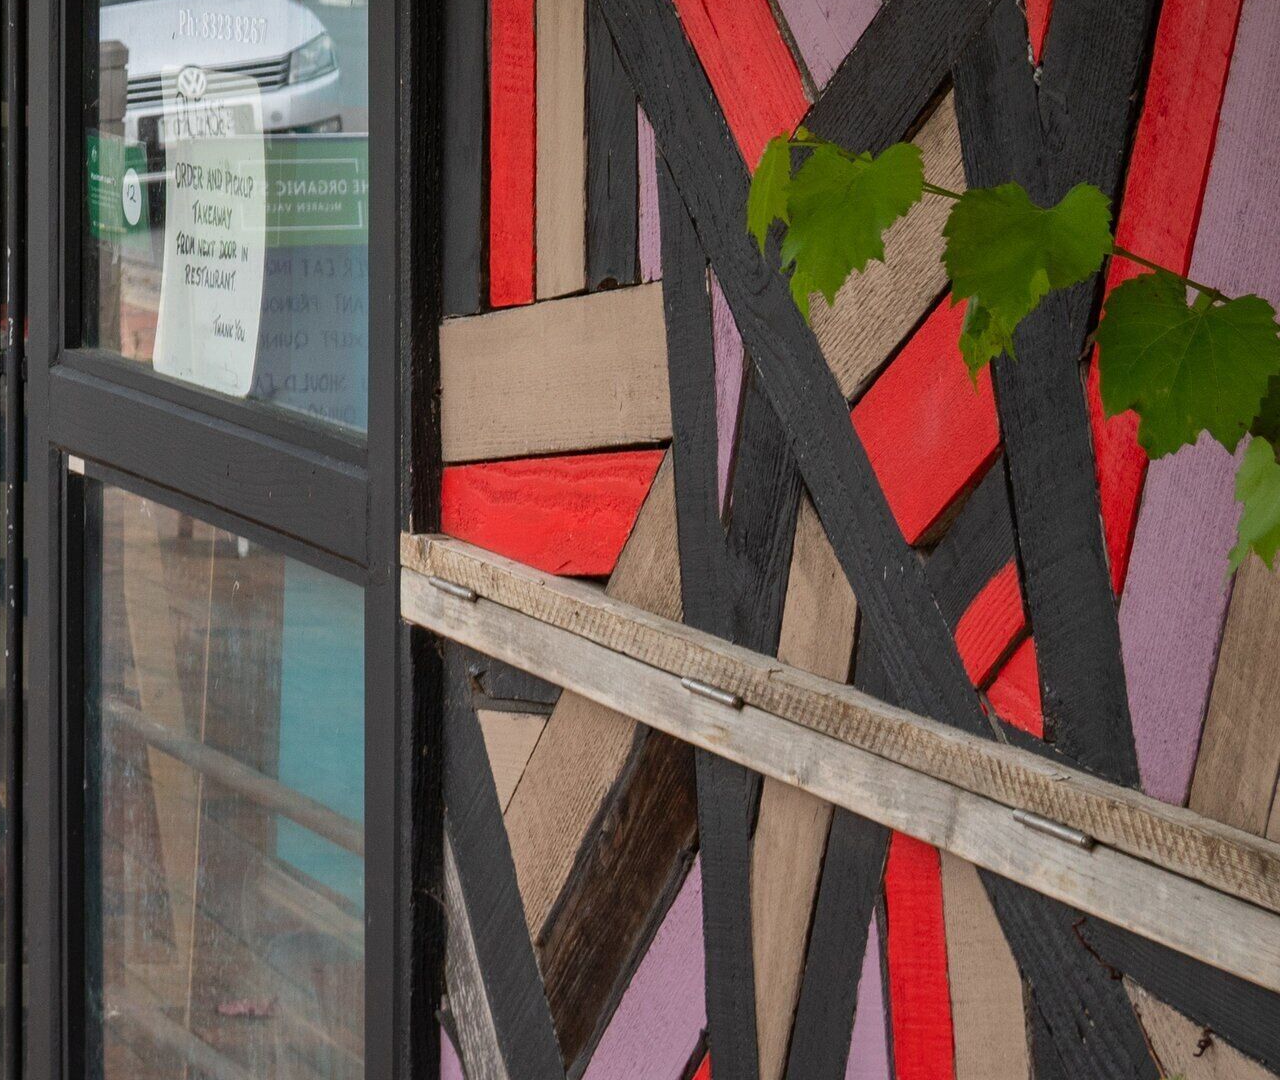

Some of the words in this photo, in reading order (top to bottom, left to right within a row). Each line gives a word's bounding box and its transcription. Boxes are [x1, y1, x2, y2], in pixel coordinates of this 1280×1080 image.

[179, 9, 198, 36] Ph:
[202, 12, 232, 40] 8323
[175, 162, 203, 191] ORDER
[206, 167, 223, 192] AND
[225, 170, 254, 199] PICKUP
[192, 199, 233, 230] TAKEAWAY
[176, 230, 195, 255] FROM
